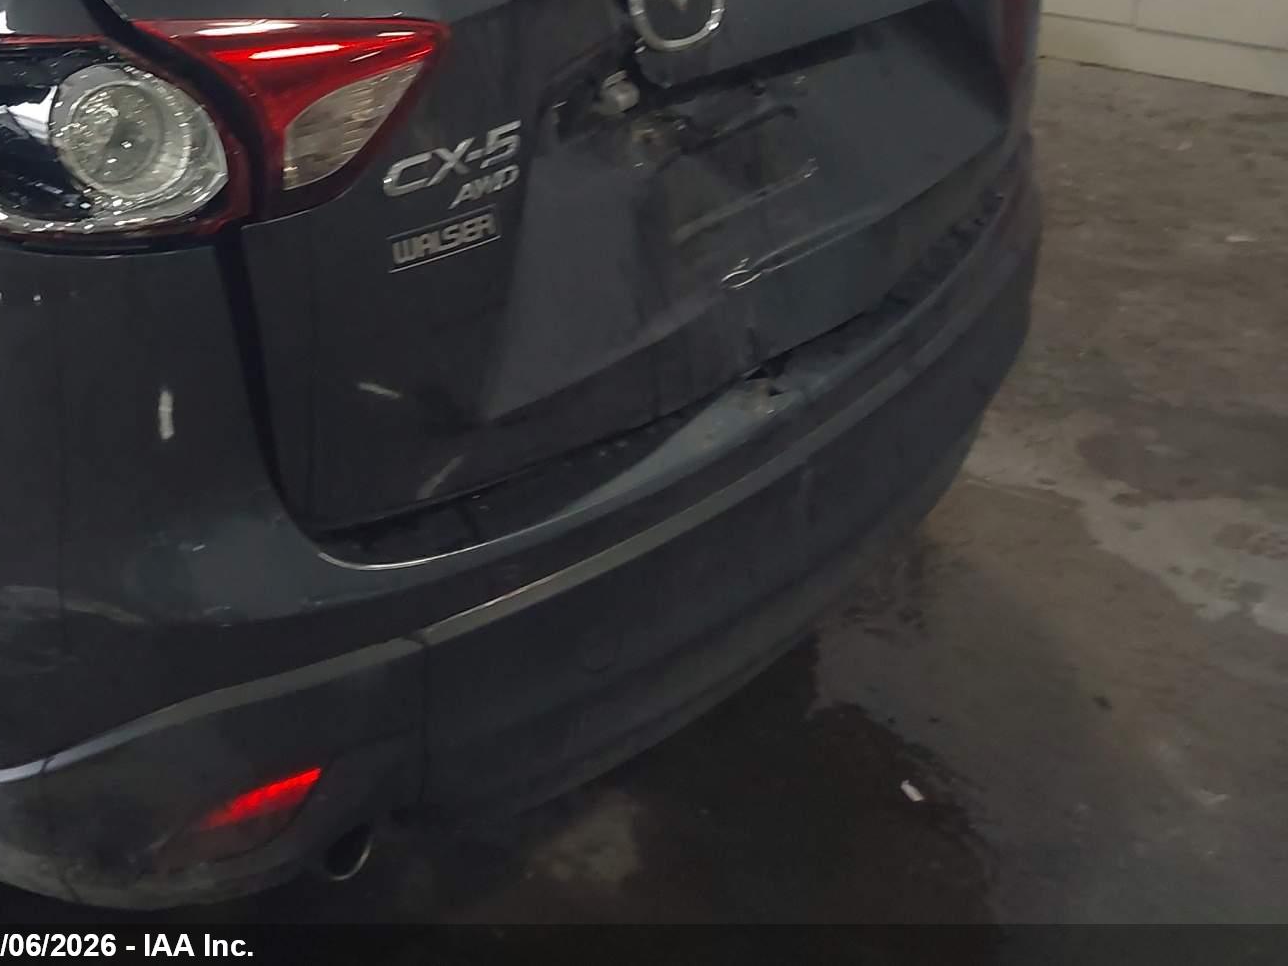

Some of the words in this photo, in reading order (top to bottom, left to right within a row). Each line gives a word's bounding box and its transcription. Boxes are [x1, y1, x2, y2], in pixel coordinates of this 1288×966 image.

[383, 120, 522, 197] CX-5
[447, 164, 520, 210] AWD
[392, 213, 497, 265] WALSER
